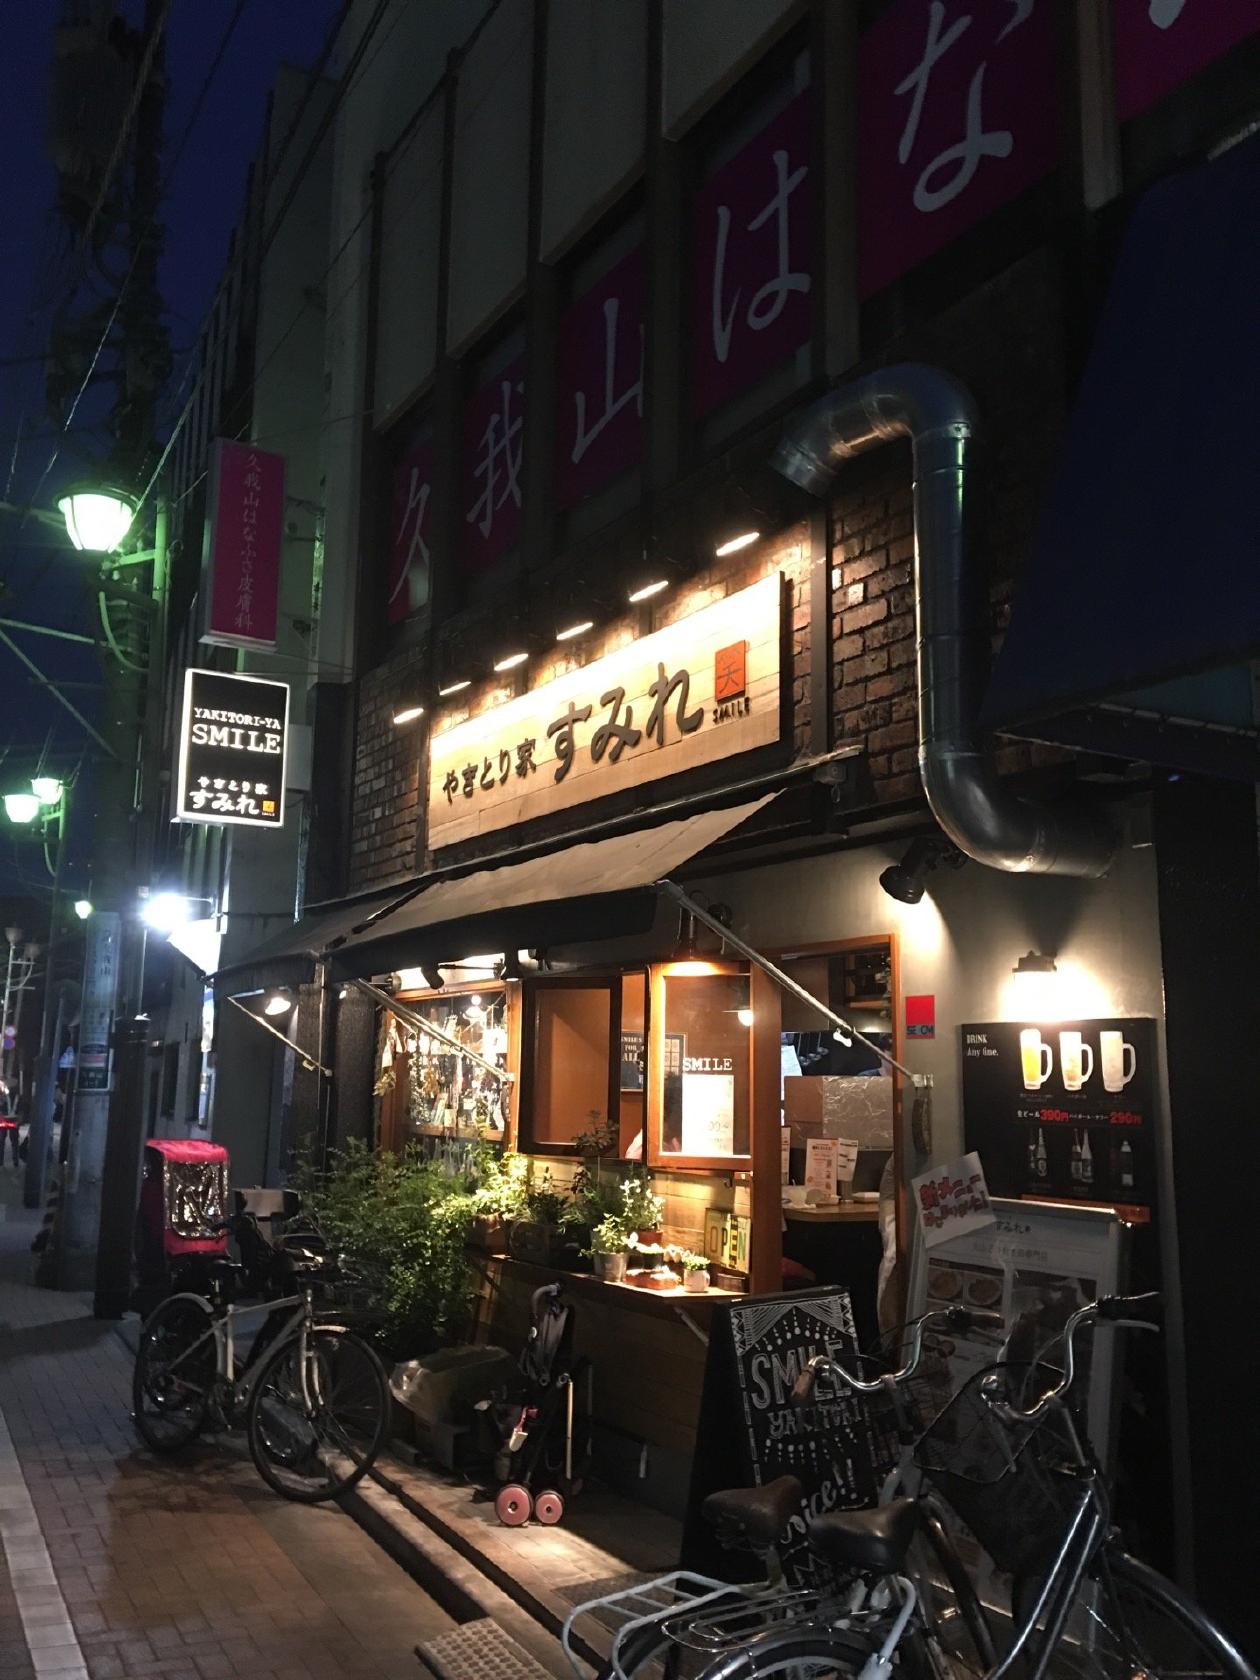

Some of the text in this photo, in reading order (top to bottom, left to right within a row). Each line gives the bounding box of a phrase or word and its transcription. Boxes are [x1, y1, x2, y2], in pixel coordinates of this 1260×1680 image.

[194, 707, 281, 730] YAKITORI-YA
[547, 662, 704, 783] すみれ
[713, 697, 750, 725] SMILE
[191, 723, 281, 754] SMILE
[189, 788, 260, 815] すみれ
[682, 1057, 732, 1072] SMILE
[710, 1225, 747, 1263] OPEN
